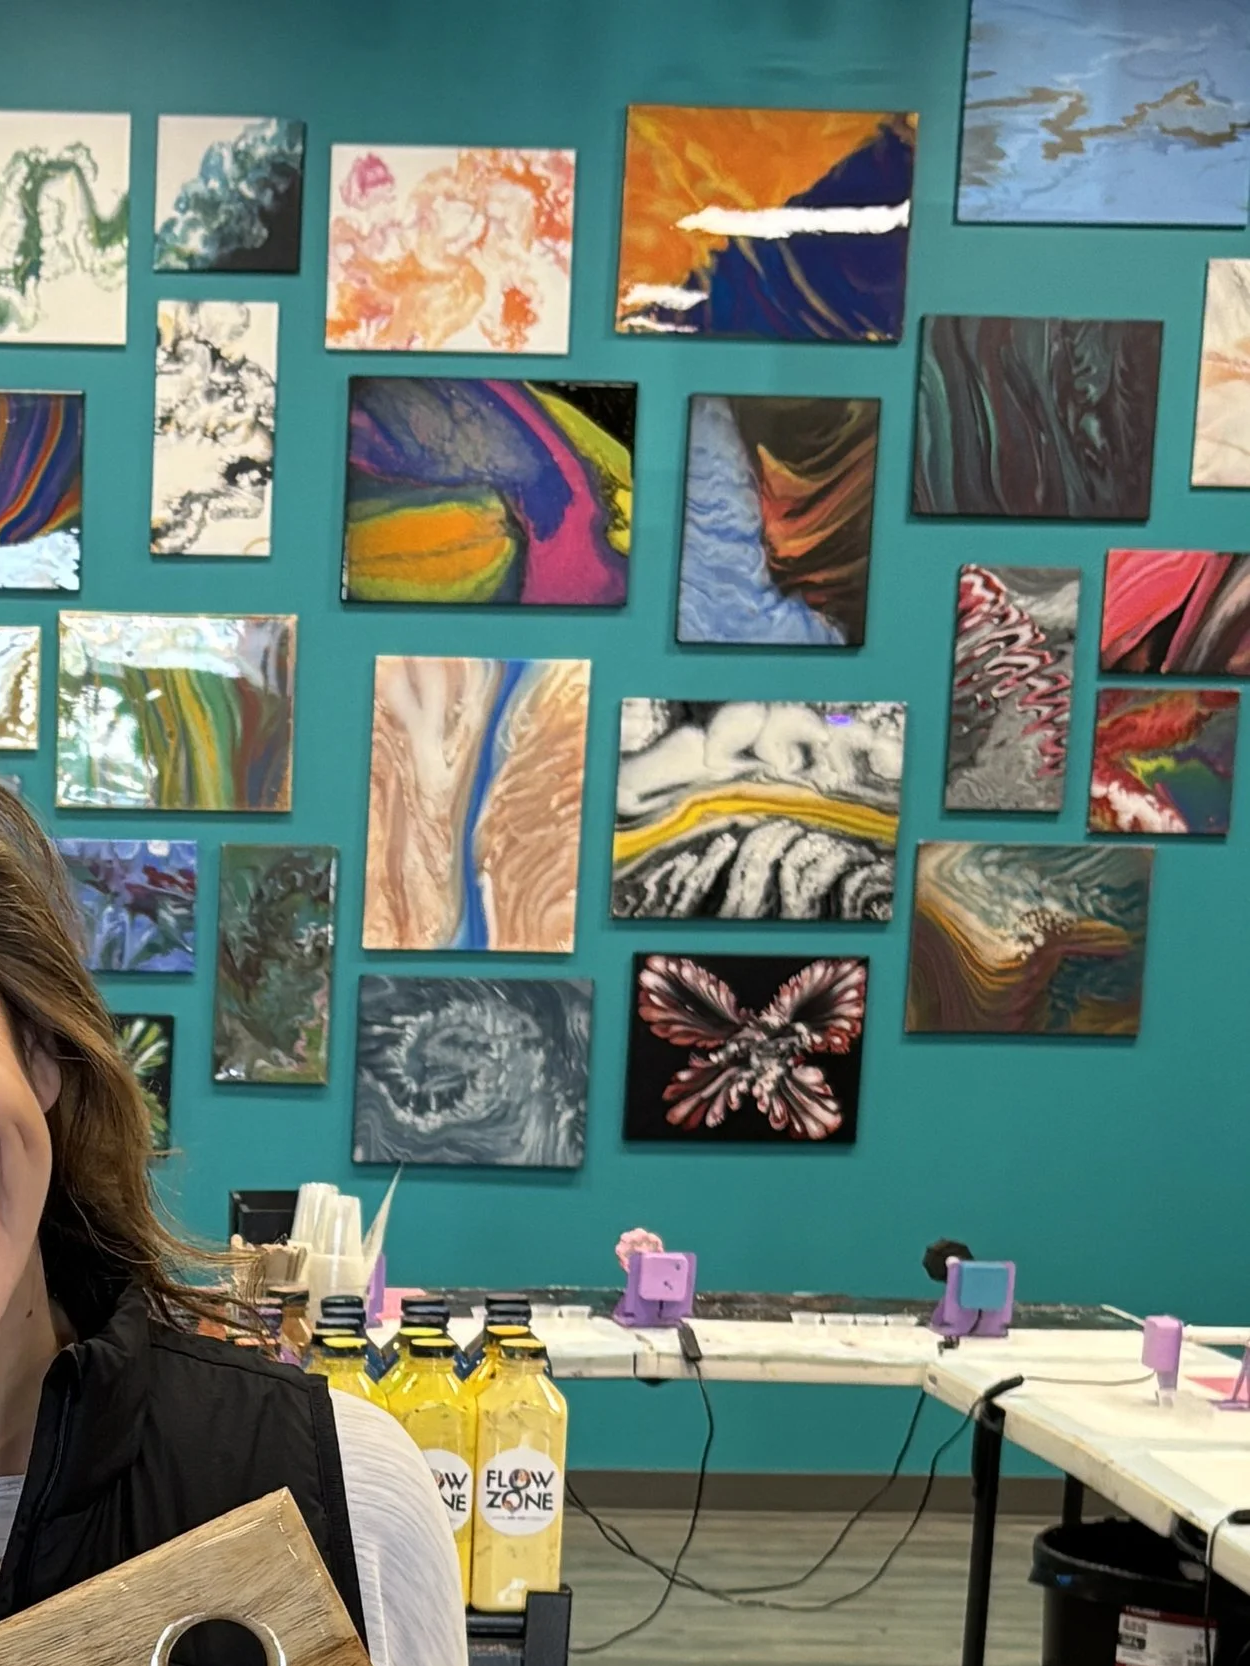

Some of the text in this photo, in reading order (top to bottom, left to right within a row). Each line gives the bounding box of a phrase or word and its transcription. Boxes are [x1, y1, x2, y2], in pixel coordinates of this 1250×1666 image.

[486, 1468, 555, 1490] FLOW
[440, 1493, 467, 1512] NE
[486, 1488, 554, 1513] ZONE
